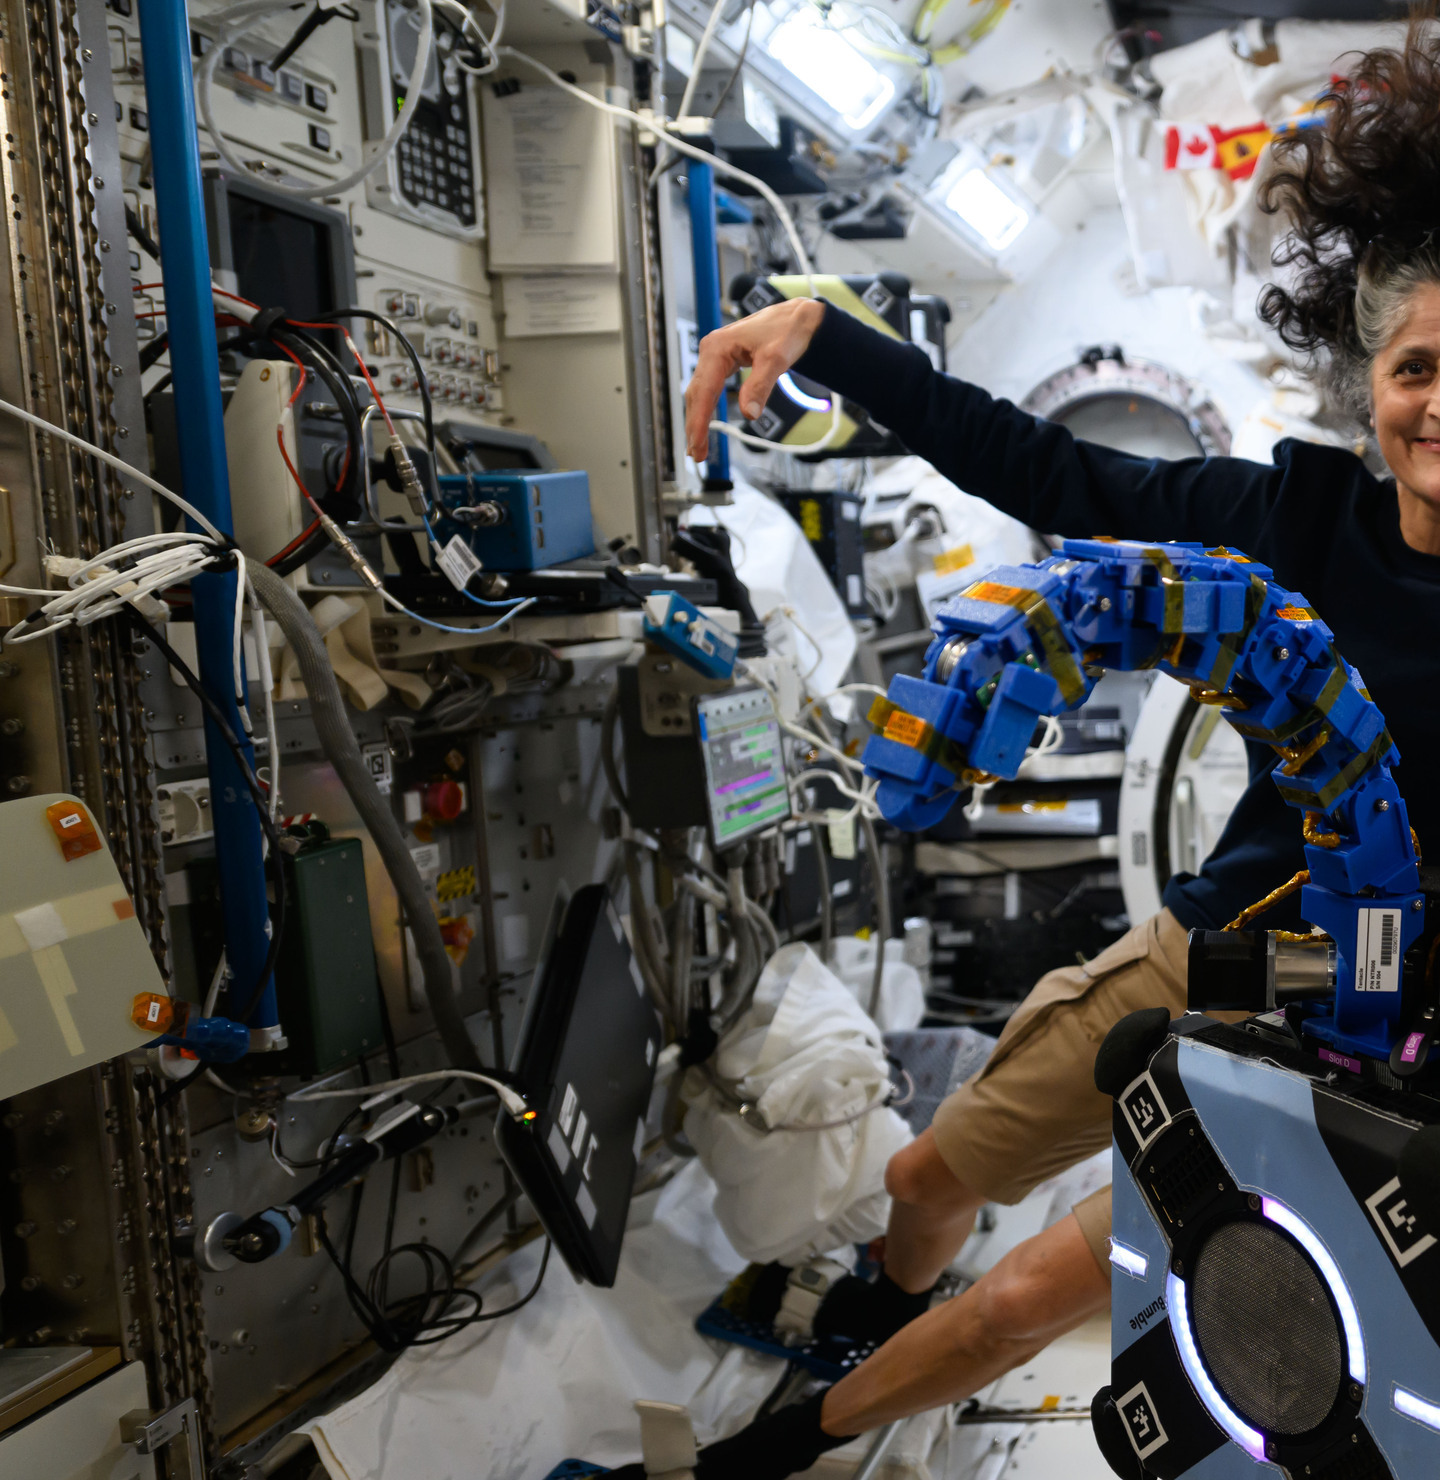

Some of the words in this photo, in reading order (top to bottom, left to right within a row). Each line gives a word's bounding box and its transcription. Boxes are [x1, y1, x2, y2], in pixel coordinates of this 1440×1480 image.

[64, 816, 78, 825] LOOP
[1328, 1053, 1342, 1066] Slot
[1343, 1058, 1350, 1068] D
[1129, 1296, 1166, 1330] Bumble
